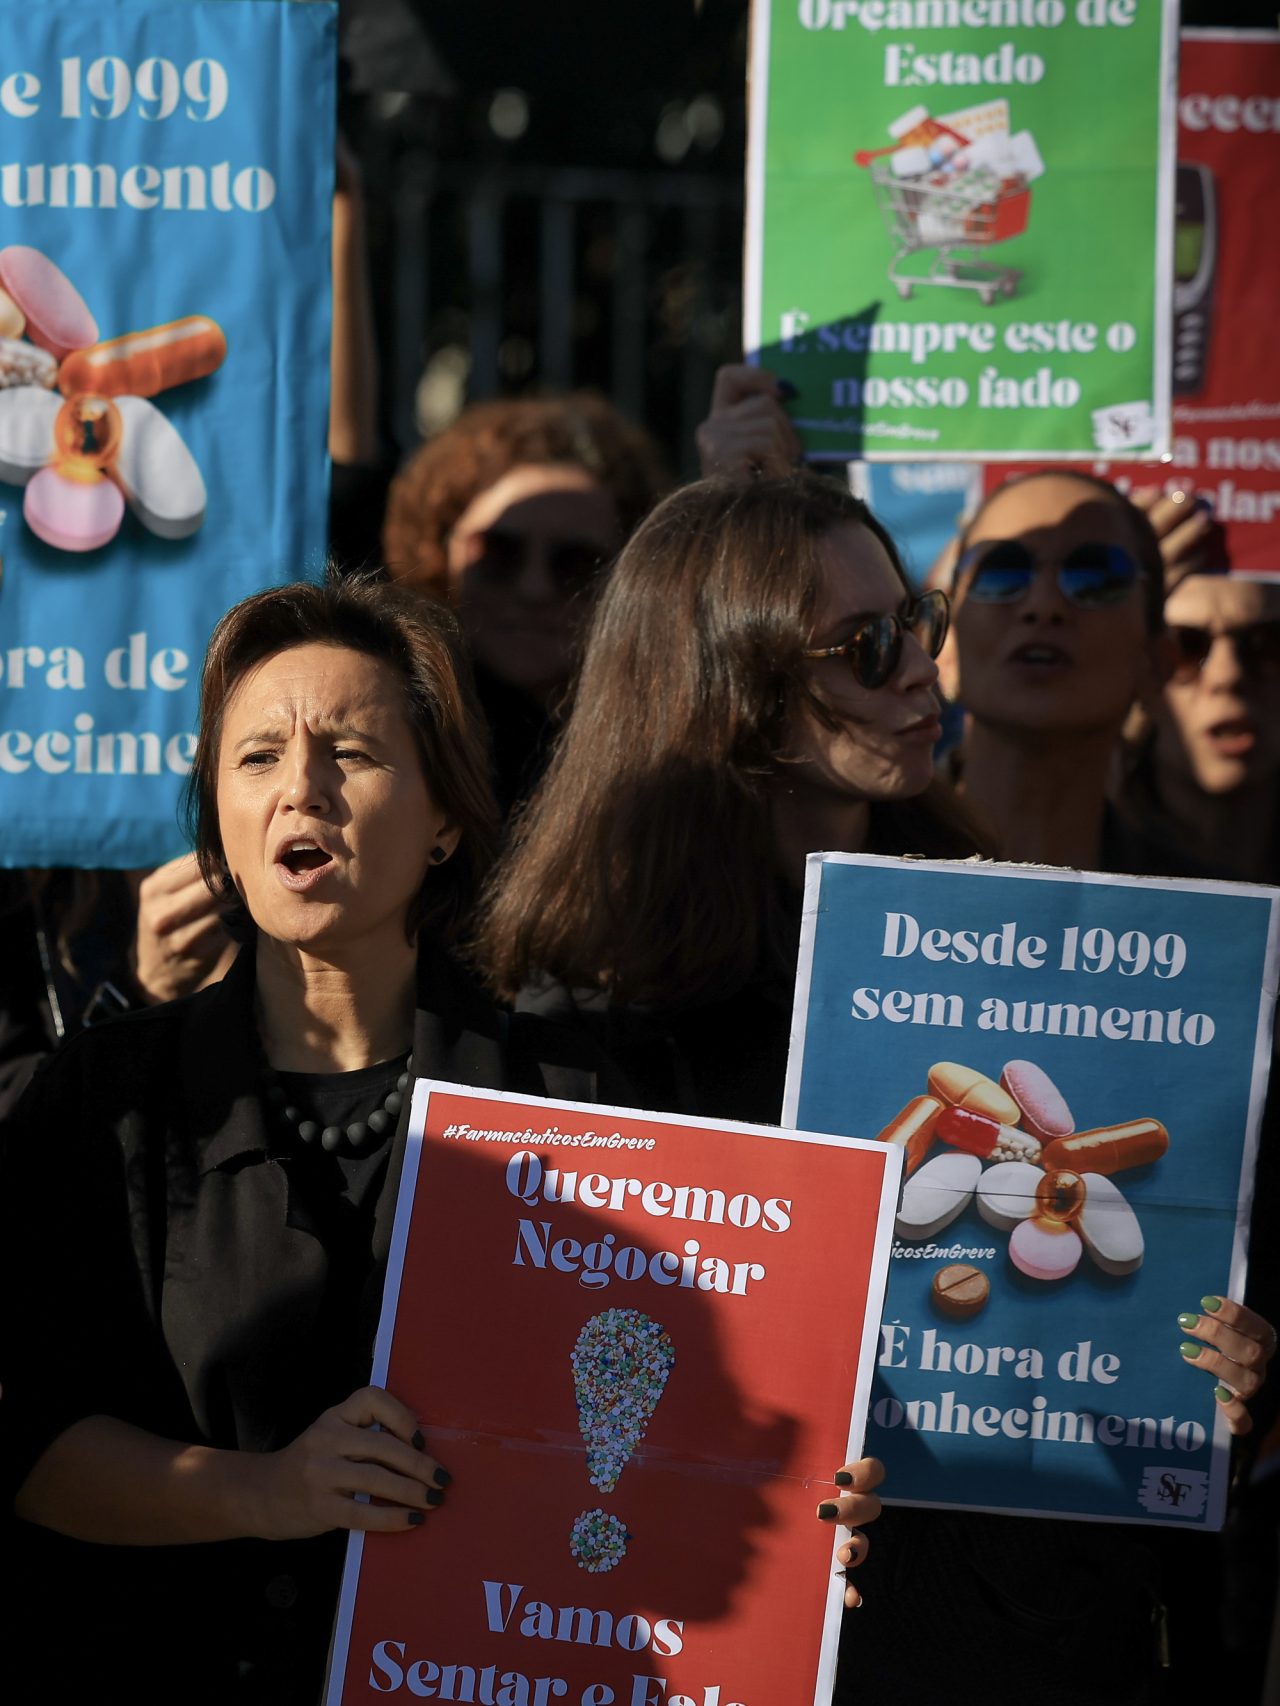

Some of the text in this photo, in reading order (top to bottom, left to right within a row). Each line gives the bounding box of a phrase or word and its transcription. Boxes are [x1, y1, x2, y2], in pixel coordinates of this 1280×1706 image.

[1076, 0, 1136, 27] de
[60, 56, 229, 122] 1999
[883, 43, 1045, 86] Estado
[781, 309, 1136, 364] É sempre este o
[833, 368, 1081, 408] nosso fado
[104, 632, 188, 692] de
[881, 912, 1186, 980] Desde 1999
[851, 985, 1215, 1047] sem aumento
[443, 1125, 655, 1151] #FarmacêuticosEmGreve
[505, 1151, 792, 1233] Queremos
[512, 1219, 765, 1296] Negociar
[879, 1319, 1120, 1385] É hora de
[869, 1391, 1206, 1452] onhecimento
[482, 1581, 684, 1657] Vamos
[368, 1640, 568, 1706] Sentar
[581, 1683, 615, 1706] e
